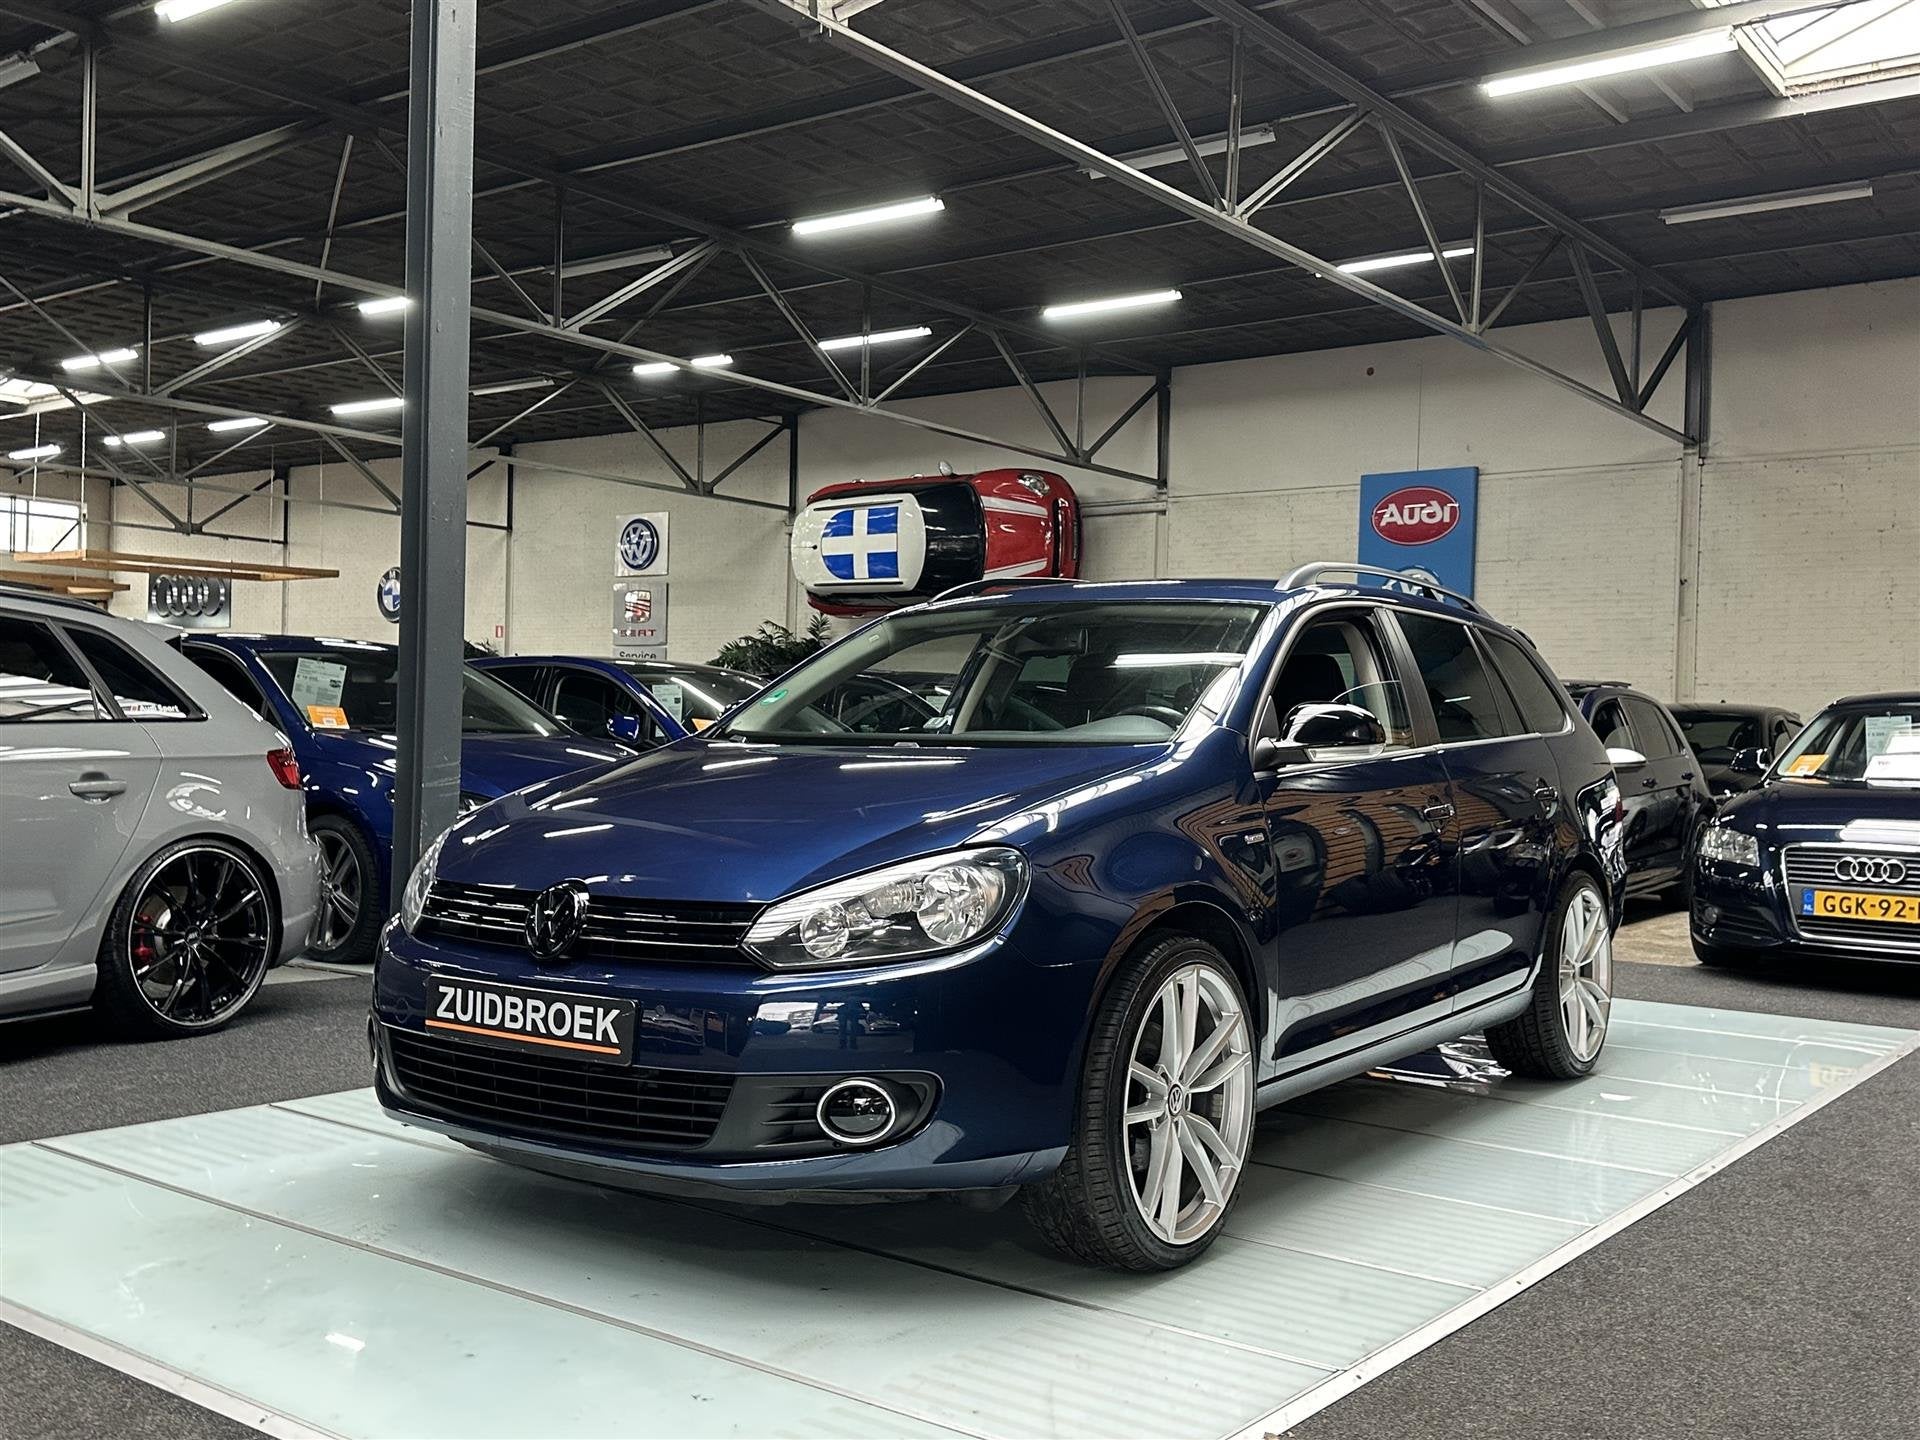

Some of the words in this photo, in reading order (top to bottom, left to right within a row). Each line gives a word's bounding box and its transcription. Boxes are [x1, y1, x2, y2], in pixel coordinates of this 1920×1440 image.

[1377, 499, 1459, 527] Audi
[619, 627, 657, 638] SEAT
[1822, 894, 1920, 920] GGK-92-
[436, 985, 621, 1044] ZUIDBROEK
